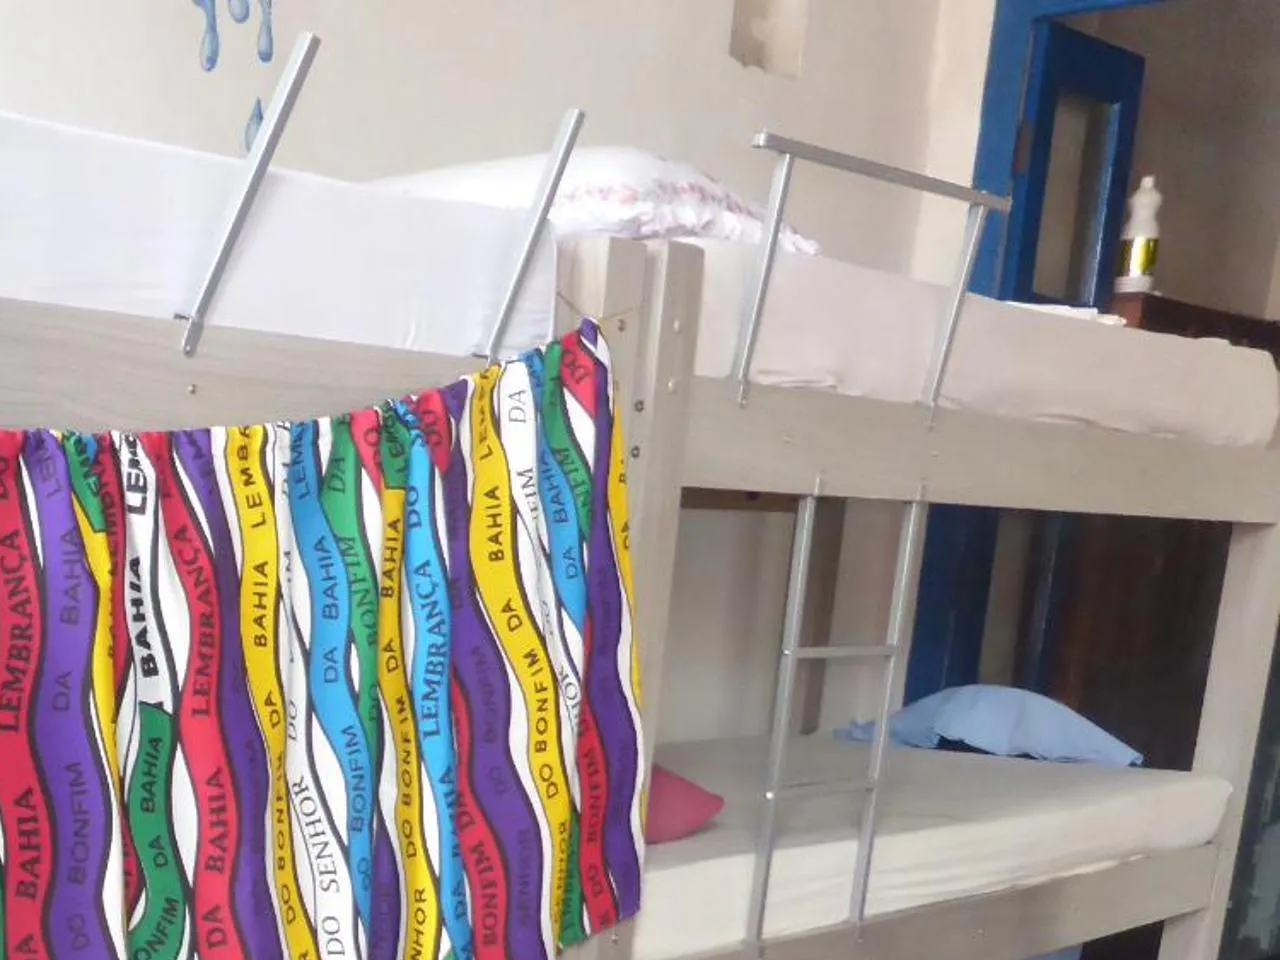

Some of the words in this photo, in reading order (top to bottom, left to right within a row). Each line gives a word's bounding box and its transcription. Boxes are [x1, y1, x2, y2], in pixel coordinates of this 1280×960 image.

[565, 350, 590, 385] DO
[325, 452, 345, 495] DA
[405, 485, 423, 530] DO
[380, 518, 400, 600] BAHIA
[488, 484, 505, 562] BAHIA
[59, 525, 82, 627] BAHIA
[312, 534, 341, 620] BAHIA
[340, 535, 378, 648] BONFIM
[565, 545, 580, 580] DA
[130, 556, 160, 678] BAHIA
[181, 523, 215, 717] LEMBRANÇA
[253, 560, 269, 648] BAHIA
[502, 598, 523, 632] DA
[323, 645, 337, 685] DA
[385, 638, 402, 674] DA
[419, 558, 448, 740] LEMBRANÇA
[51, 672, 72, 712] DA
[263, 690, 280, 728] DA
[526, 646, 549, 755] BONFIM
[140, 736, 163, 814] BAHIA
[342, 725, 365, 832] BONFIM
[537, 763, 558, 800] DO
[12, 786, 37, 902] BAHIA
[67, 760, 88, 886] BONFIM
[149, 834, 168, 869] DA
[204, 768, 228, 873] BAHIA
[292, 776, 340, 892] SENHOR
[401, 819, 417, 860] DO
[65, 912, 90, 953] DO
[202, 905, 226, 950] DA
[279, 882, 297, 924] DO
[475, 843, 498, 947] BONFIM
[321, 915, 345, 957] DO
